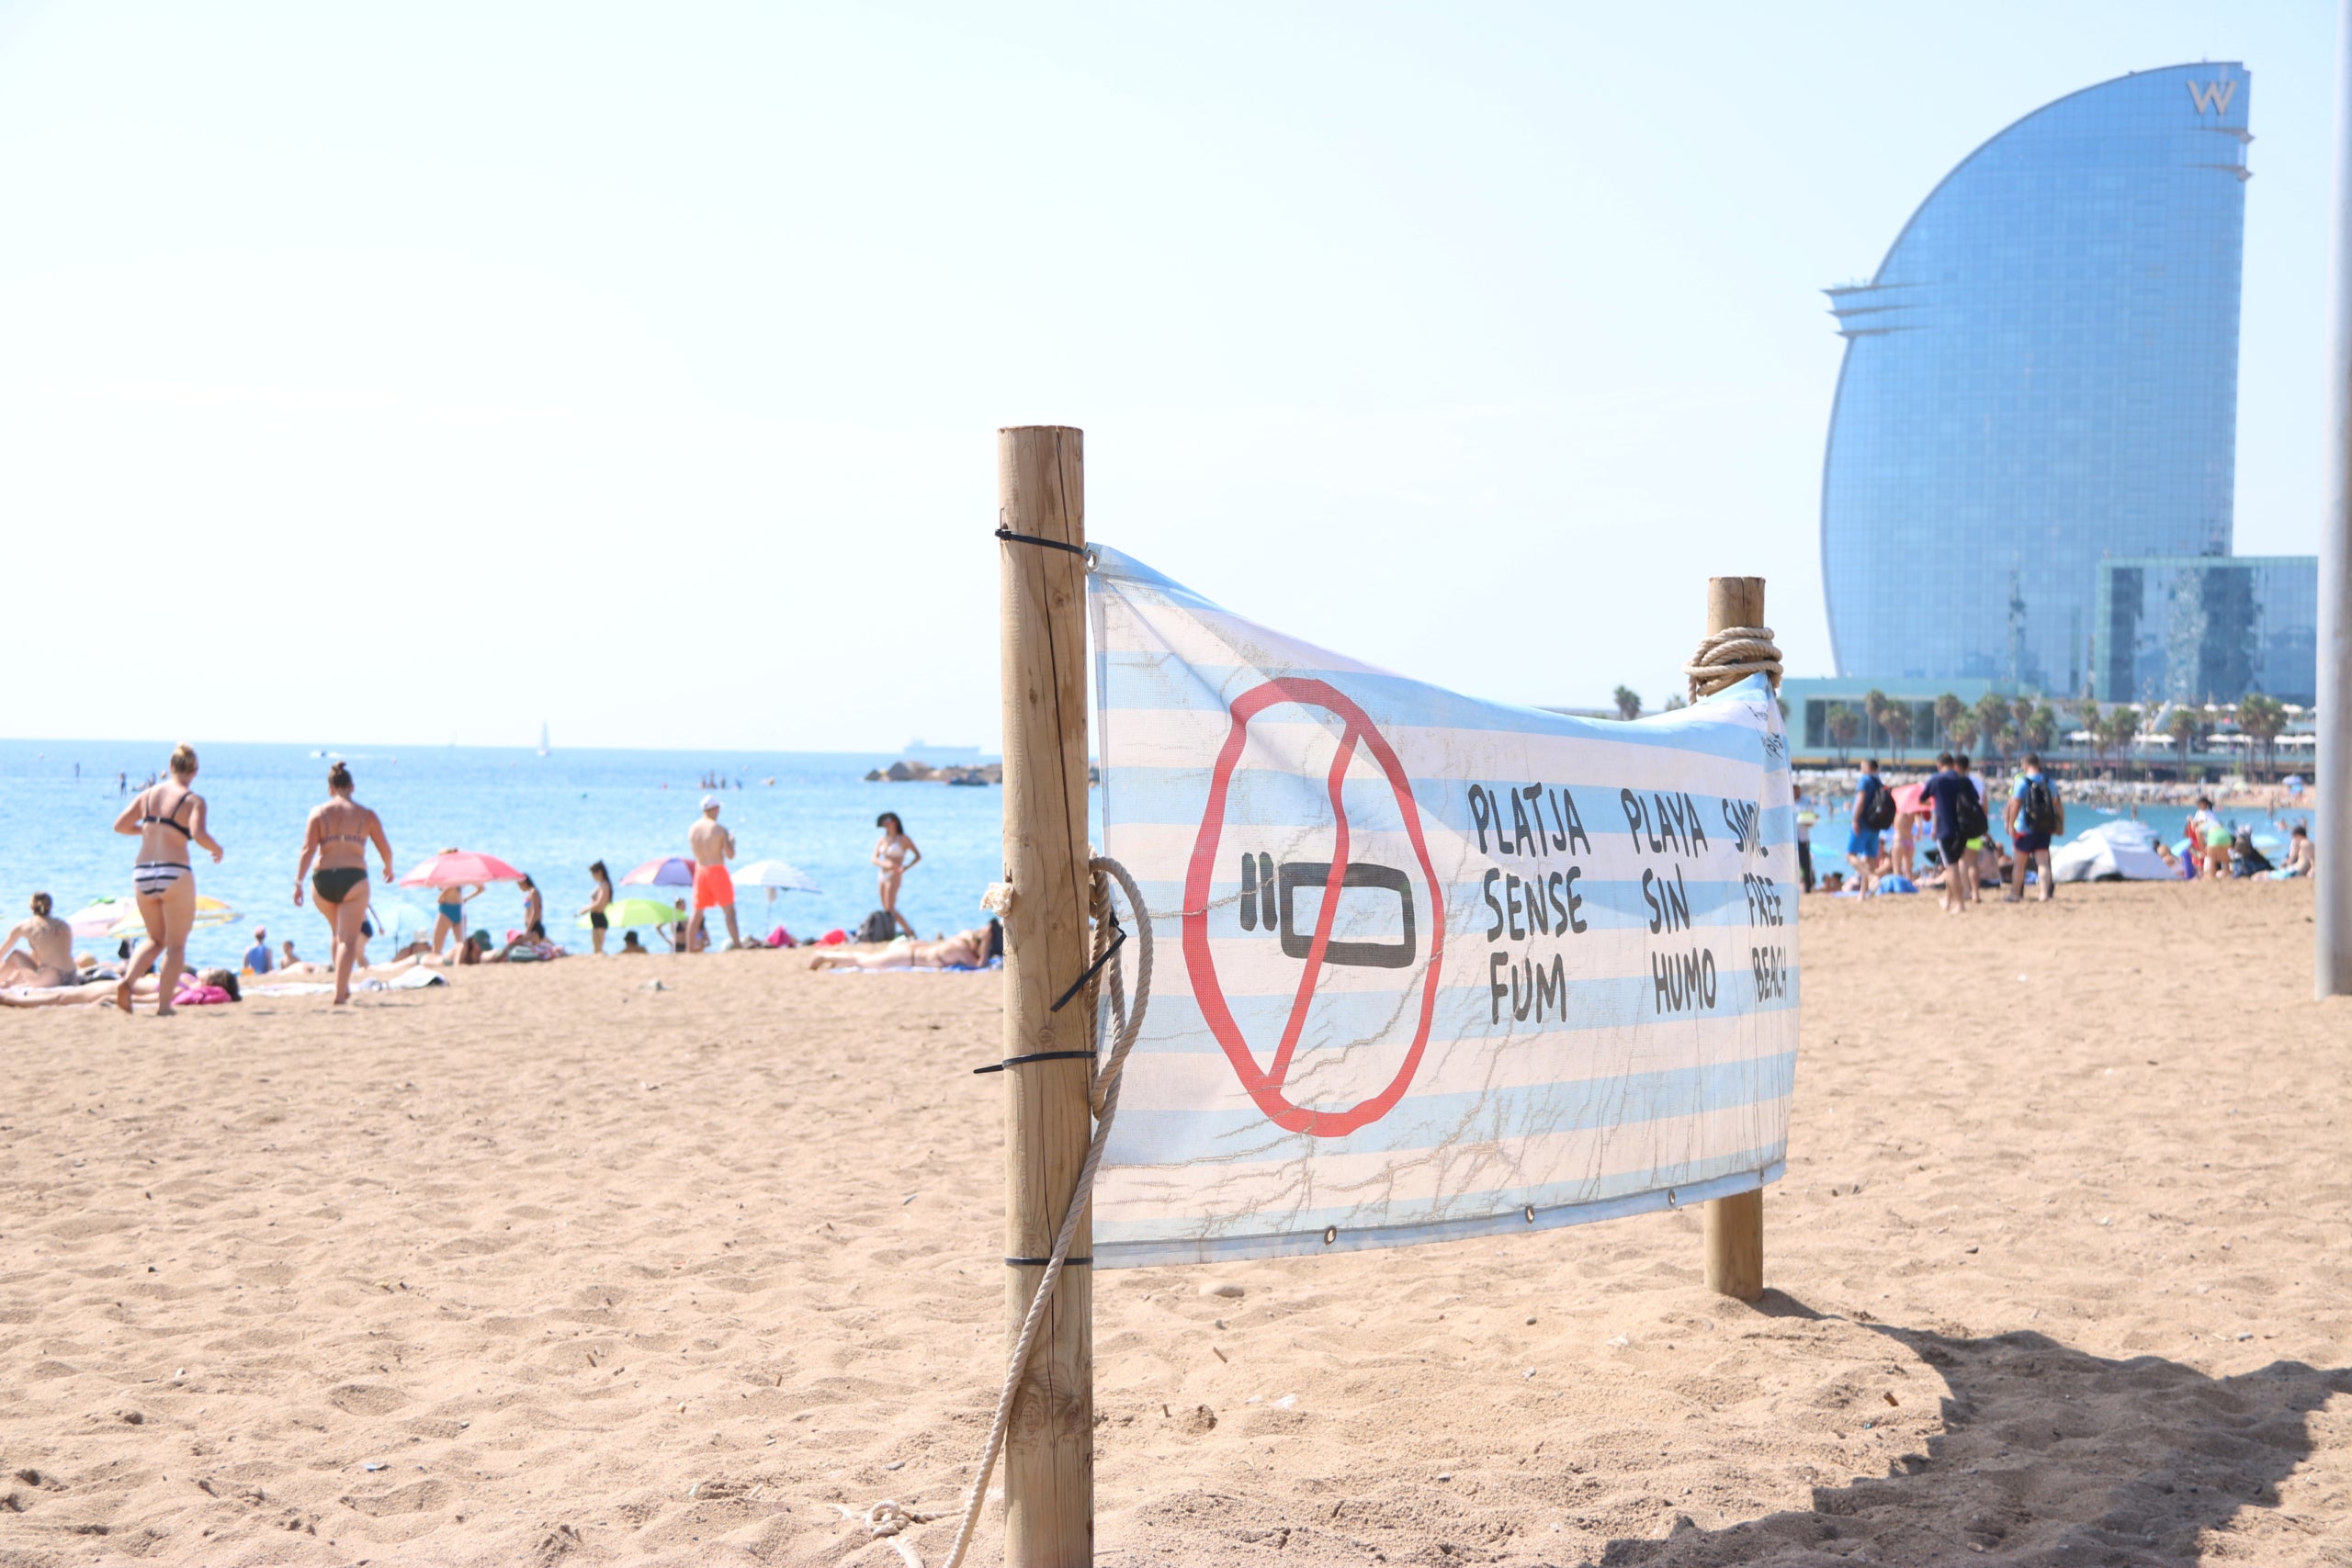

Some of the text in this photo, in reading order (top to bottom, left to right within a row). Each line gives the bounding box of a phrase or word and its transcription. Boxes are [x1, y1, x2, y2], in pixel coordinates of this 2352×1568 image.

[2187, 80, 2238, 116] W
[1467, 782, 1591, 858] PLATJA
[1620, 788, 1708, 858] PLAYA
[1722, 798, 1769, 858] SMO
[1483, 865, 1588, 942] SENSE
[1642, 863, 1690, 934] SIN
[1743, 872, 1783, 926] FREE
[1490, 951, 1566, 1025] FUM
[1652, 947, 1716, 1015] HUMO
[1752, 946, 1786, 1002] BEACH
